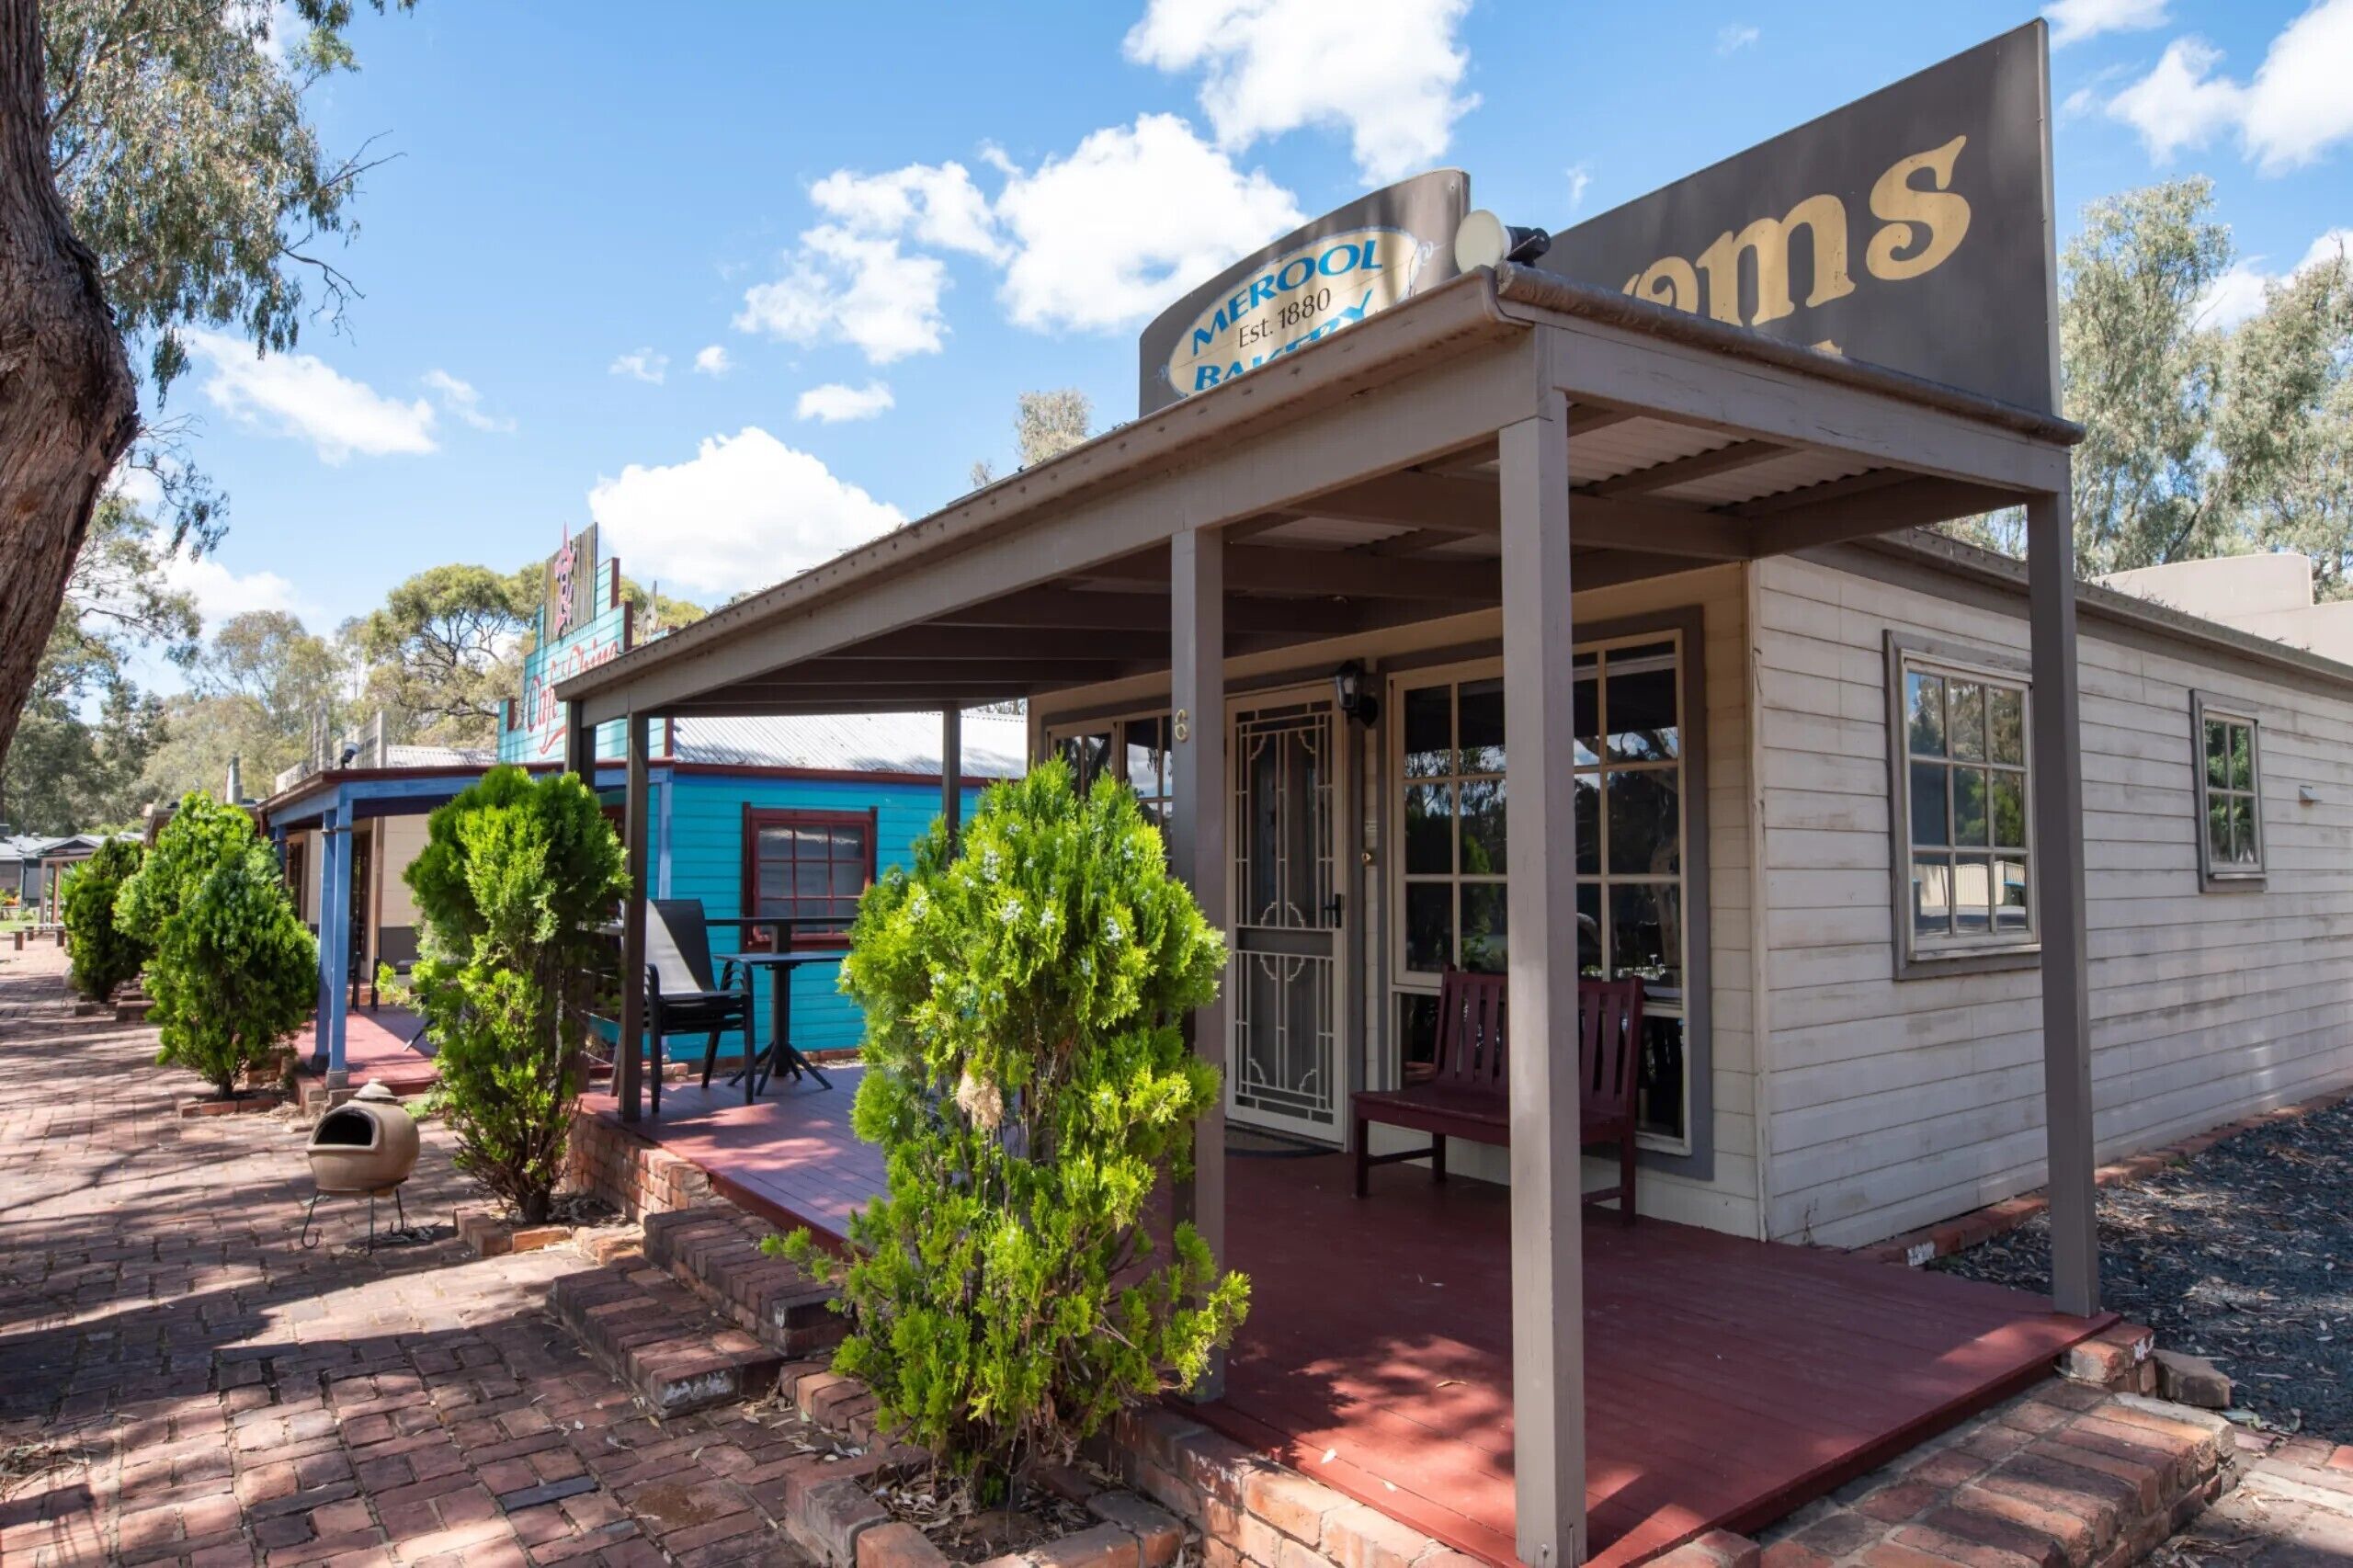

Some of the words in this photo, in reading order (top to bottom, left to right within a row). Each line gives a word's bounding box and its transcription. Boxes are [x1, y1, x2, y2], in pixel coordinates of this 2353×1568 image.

[1192, 239, 1382, 357] MEROOL
[1239, 317, 1273, 348] Est.
[1278, 288, 1331, 329] 1880
[1175, 708, 1188, 742] 6
